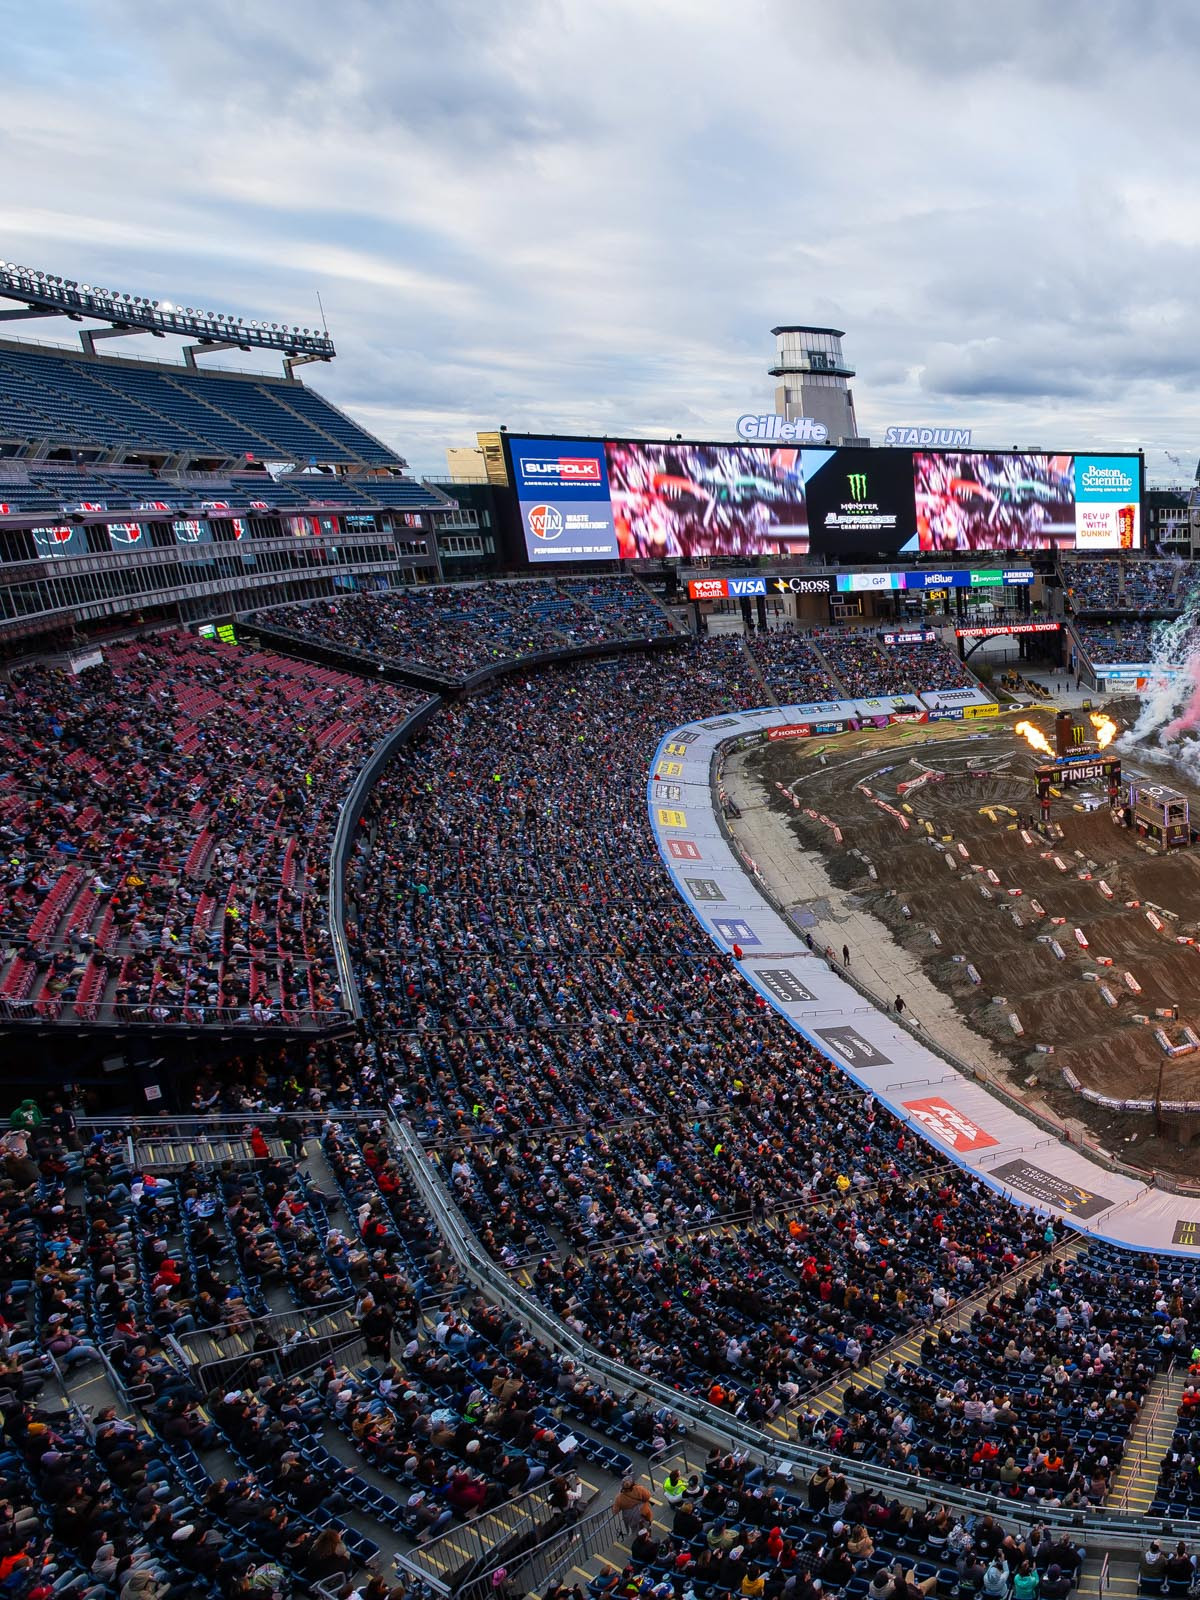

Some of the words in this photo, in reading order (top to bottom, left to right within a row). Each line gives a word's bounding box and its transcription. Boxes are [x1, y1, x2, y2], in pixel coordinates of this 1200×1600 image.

[737, 416, 828, 441] Gillette
[885, 427, 972, 445] STADIUM
[525, 463, 595, 474] SUFFOLK
[1088, 465, 1121, 477] Boston
[1082, 472, 1132, 486] Scientific
[703, 581, 722, 589] CVS
[730, 580, 765, 594] VISA
[924, 574, 953, 586] jetBlue
[959, 628, 983, 636] TOYOTA
[985, 626, 1009, 634] TOYOTA
[1010, 625, 1034, 633] TOYOTA
[1035, 623, 1058, 632] TOYOTA
[778, 728, 809, 736] HONDA
[1061, 765, 1104, 781] FINISH
[1020, 1169, 1047, 1184] SPORTS
[1024, 1167, 1073, 1191] COMMISSION
[1004, 1176, 1031, 1193] SPORTS
[1009, 1174, 1058, 1198] COMMISSION
[1047, 1182, 1069, 1193] UTAH
[1031, 1189, 1053, 1201] UTAH
